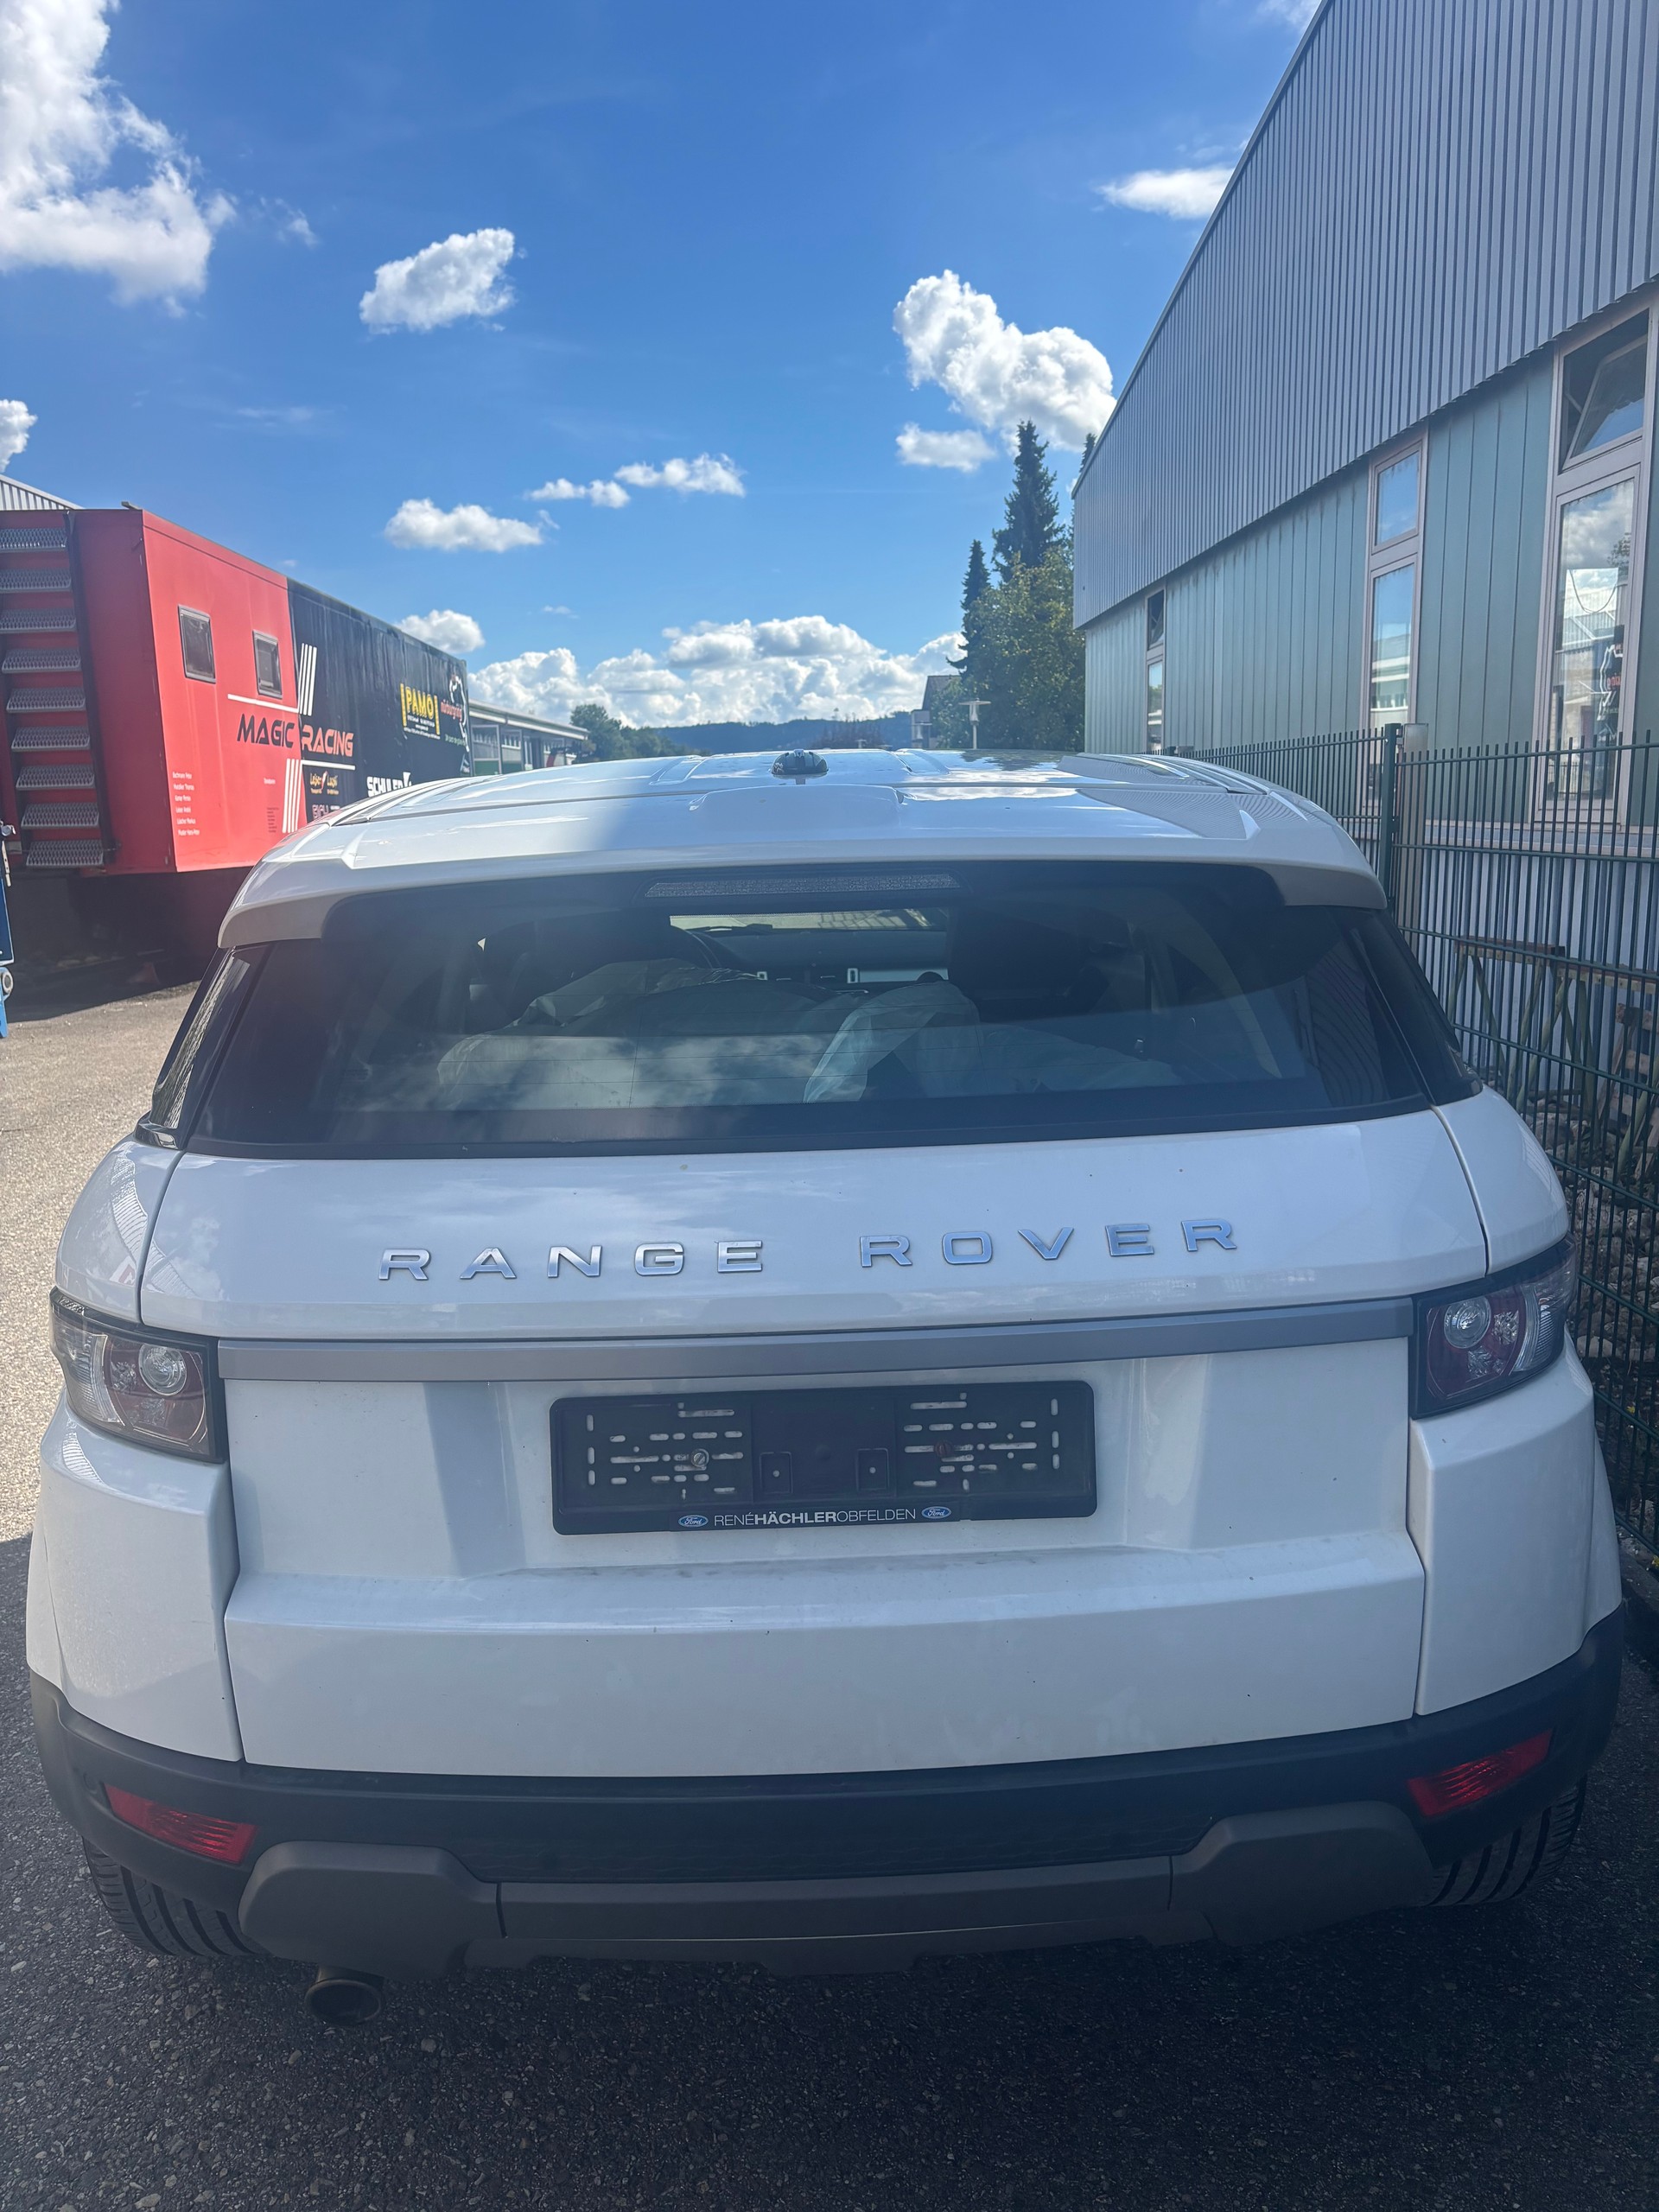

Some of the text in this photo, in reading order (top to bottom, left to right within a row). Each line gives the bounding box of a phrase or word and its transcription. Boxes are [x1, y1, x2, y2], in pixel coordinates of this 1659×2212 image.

[405, 686, 435, 720] PAMO
[237, 713, 354, 757] MAGIC RACING
[378, 1218, 1238, 1281] RANGE ROVER
[683, 1516, 703, 1526] Ford
[925, 1507, 947, 1518] Ford
